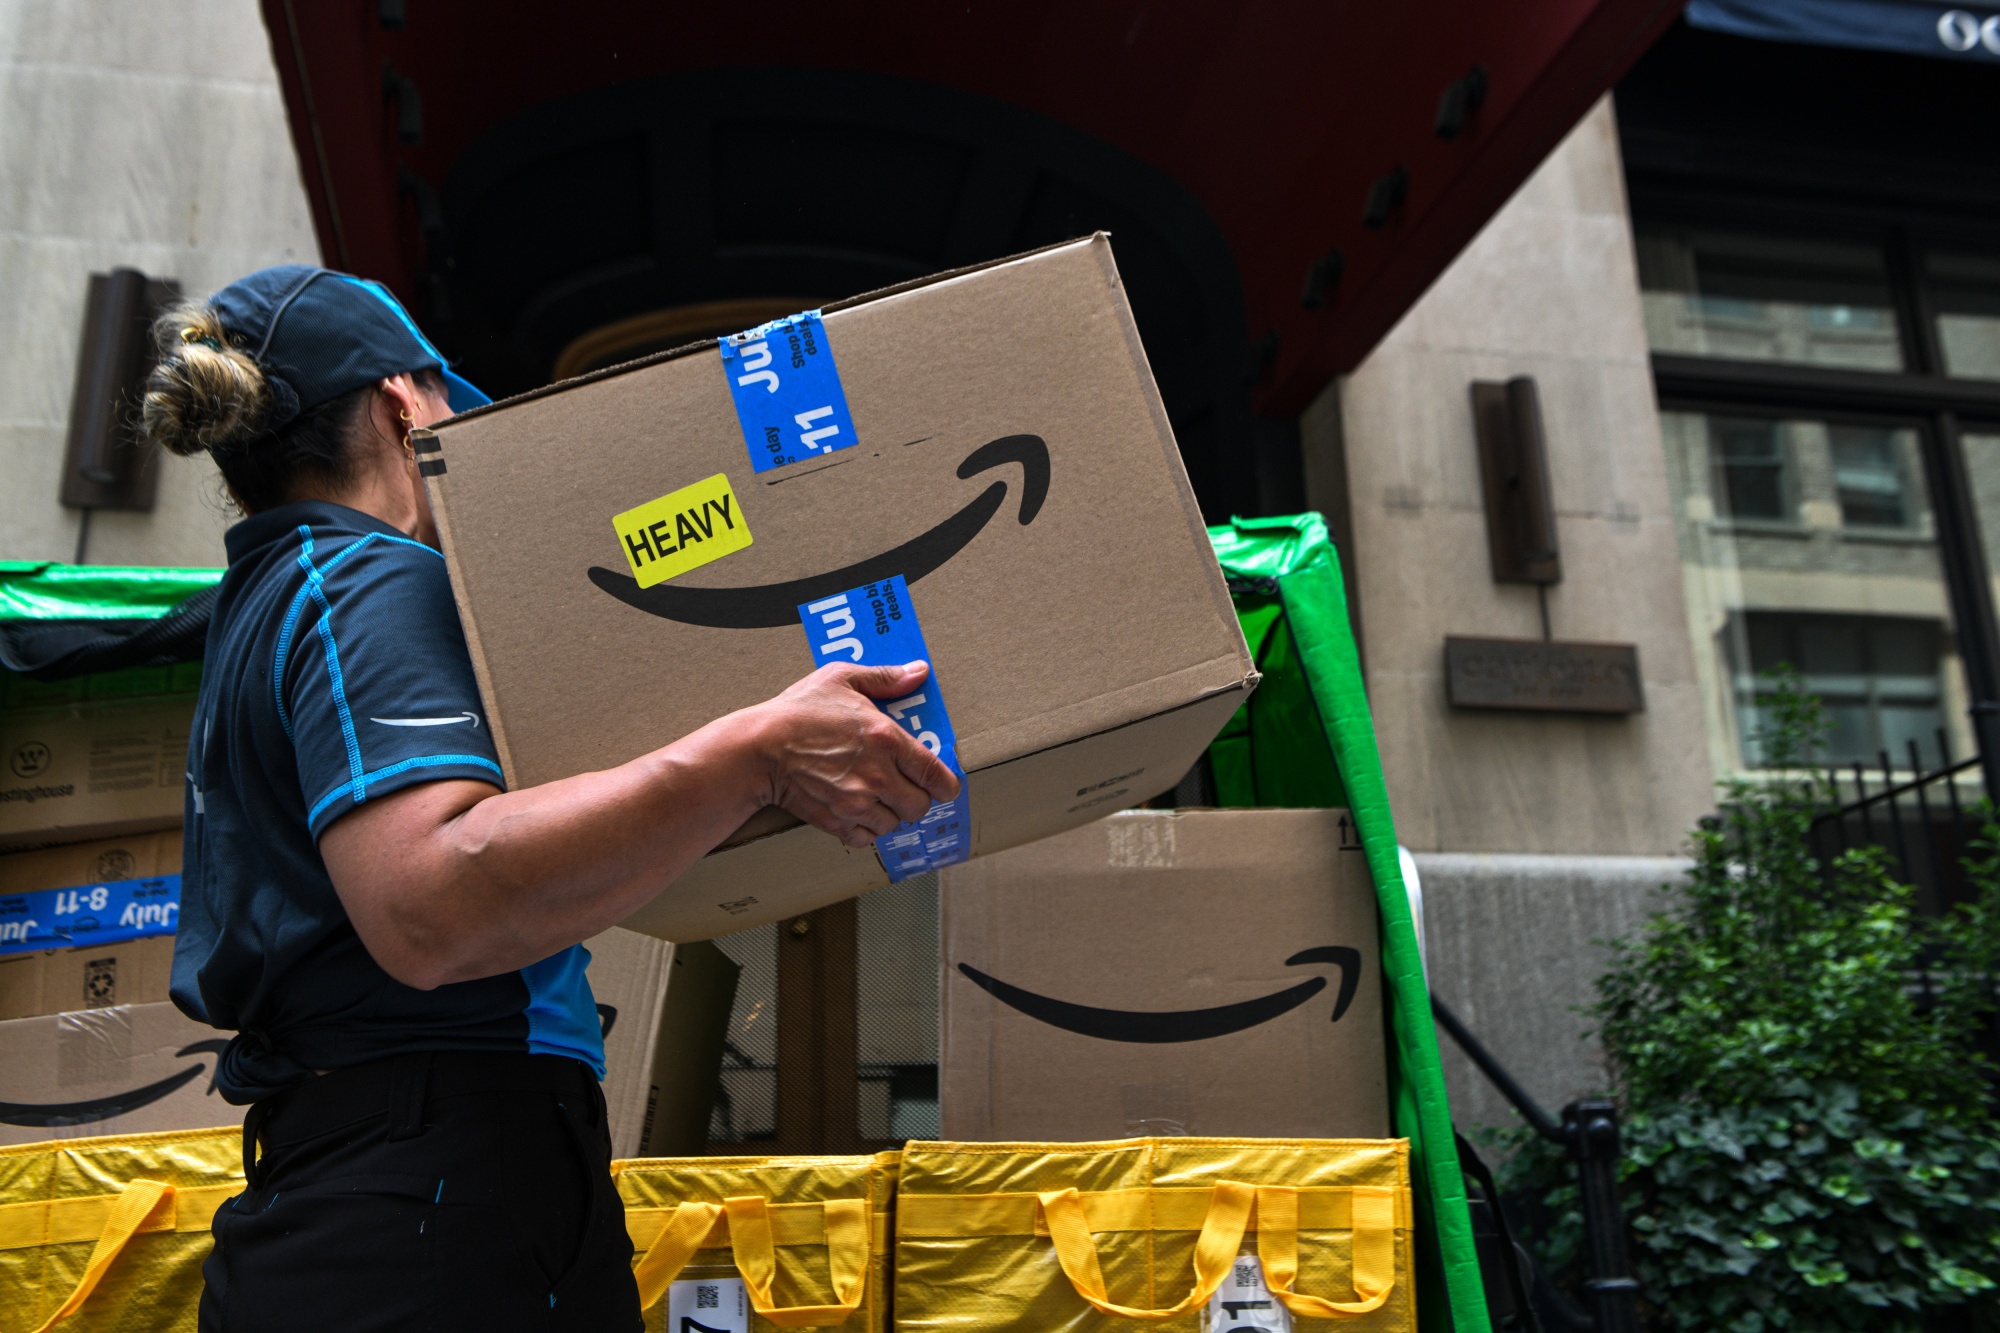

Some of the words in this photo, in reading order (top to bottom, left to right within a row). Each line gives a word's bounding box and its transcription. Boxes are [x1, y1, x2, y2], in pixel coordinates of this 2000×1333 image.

[788, 335, 805, 369] Shop
[764, 426, 782, 453] day
[625, 493, 735, 568] HEAVY
[871, 601, 890, 635] Shop
[54, 887, 109, 915] 8-11
[119, 902, 179, 930] July
